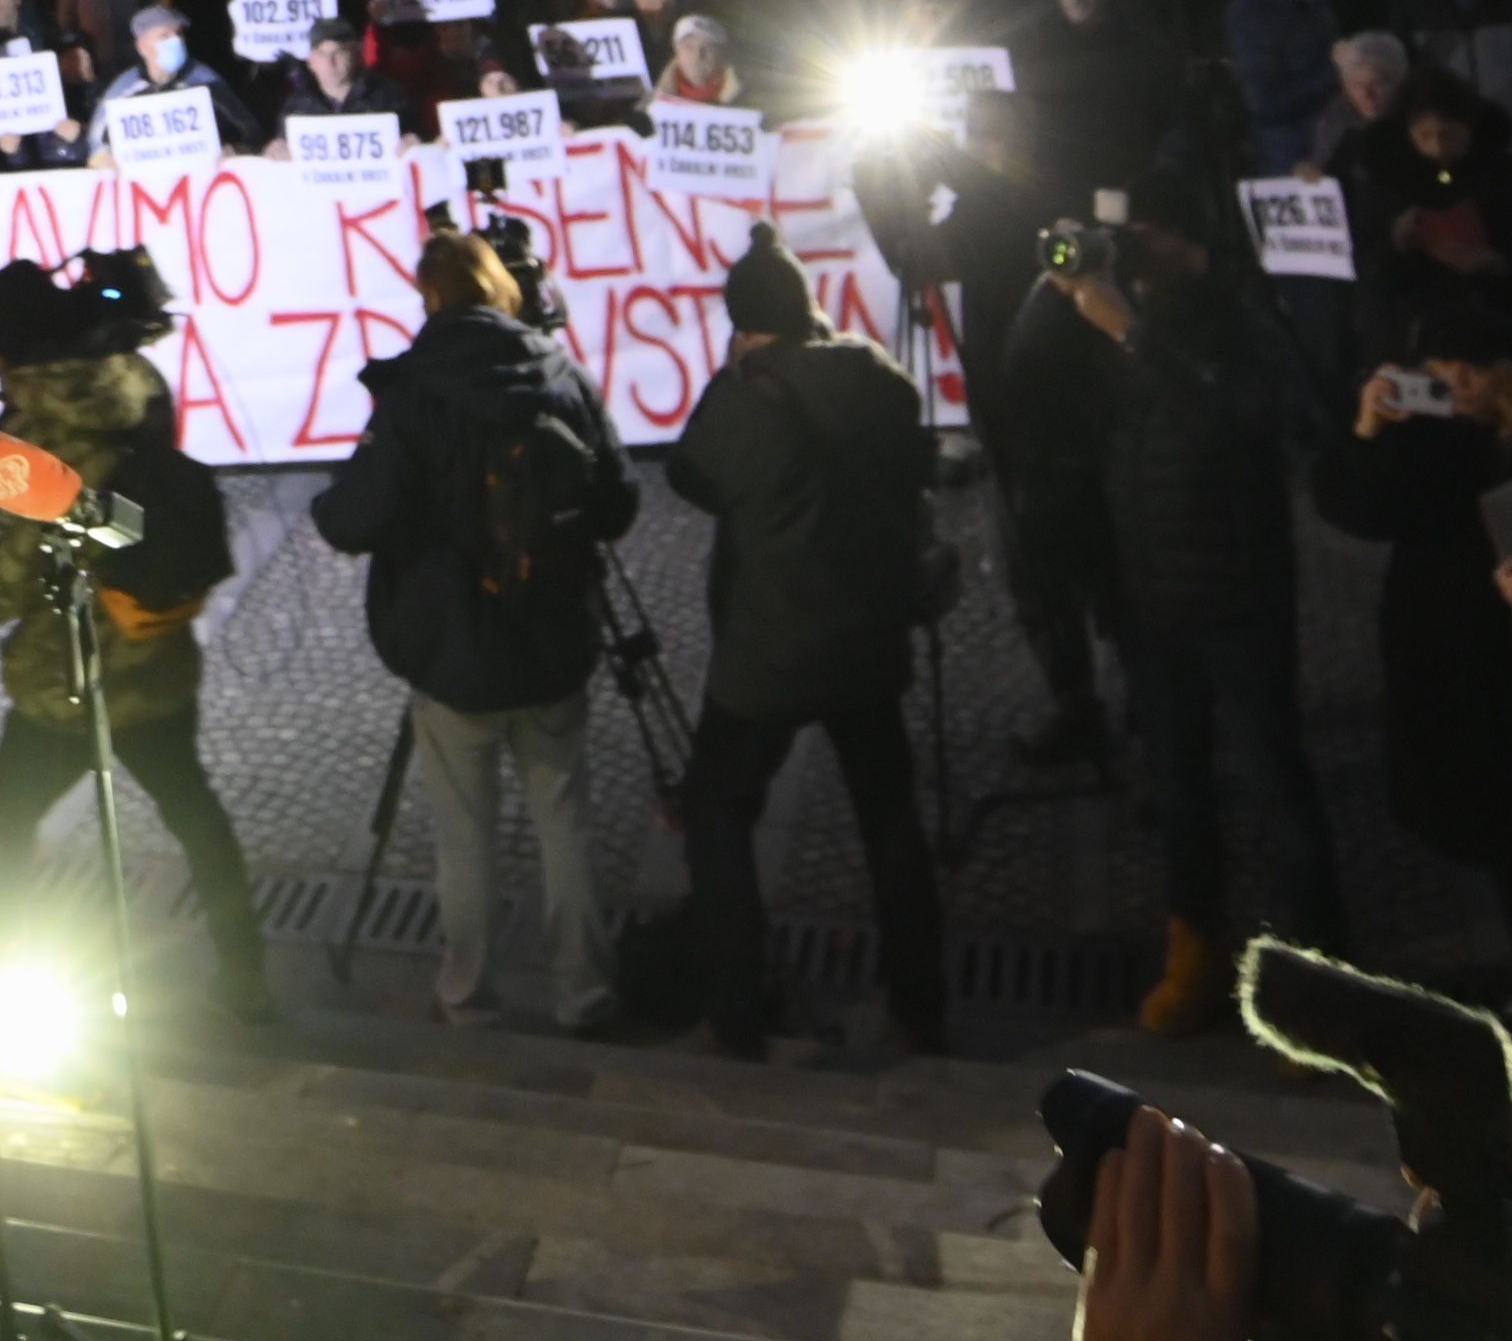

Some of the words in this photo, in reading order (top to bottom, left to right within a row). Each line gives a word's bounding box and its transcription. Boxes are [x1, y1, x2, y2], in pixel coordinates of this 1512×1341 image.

[121, 106, 200, 139] 108.162
[455, 108, 544, 146] 121.987
[660, 120, 754, 155] 114.653
[299, 131, 384, 162] 99.875
